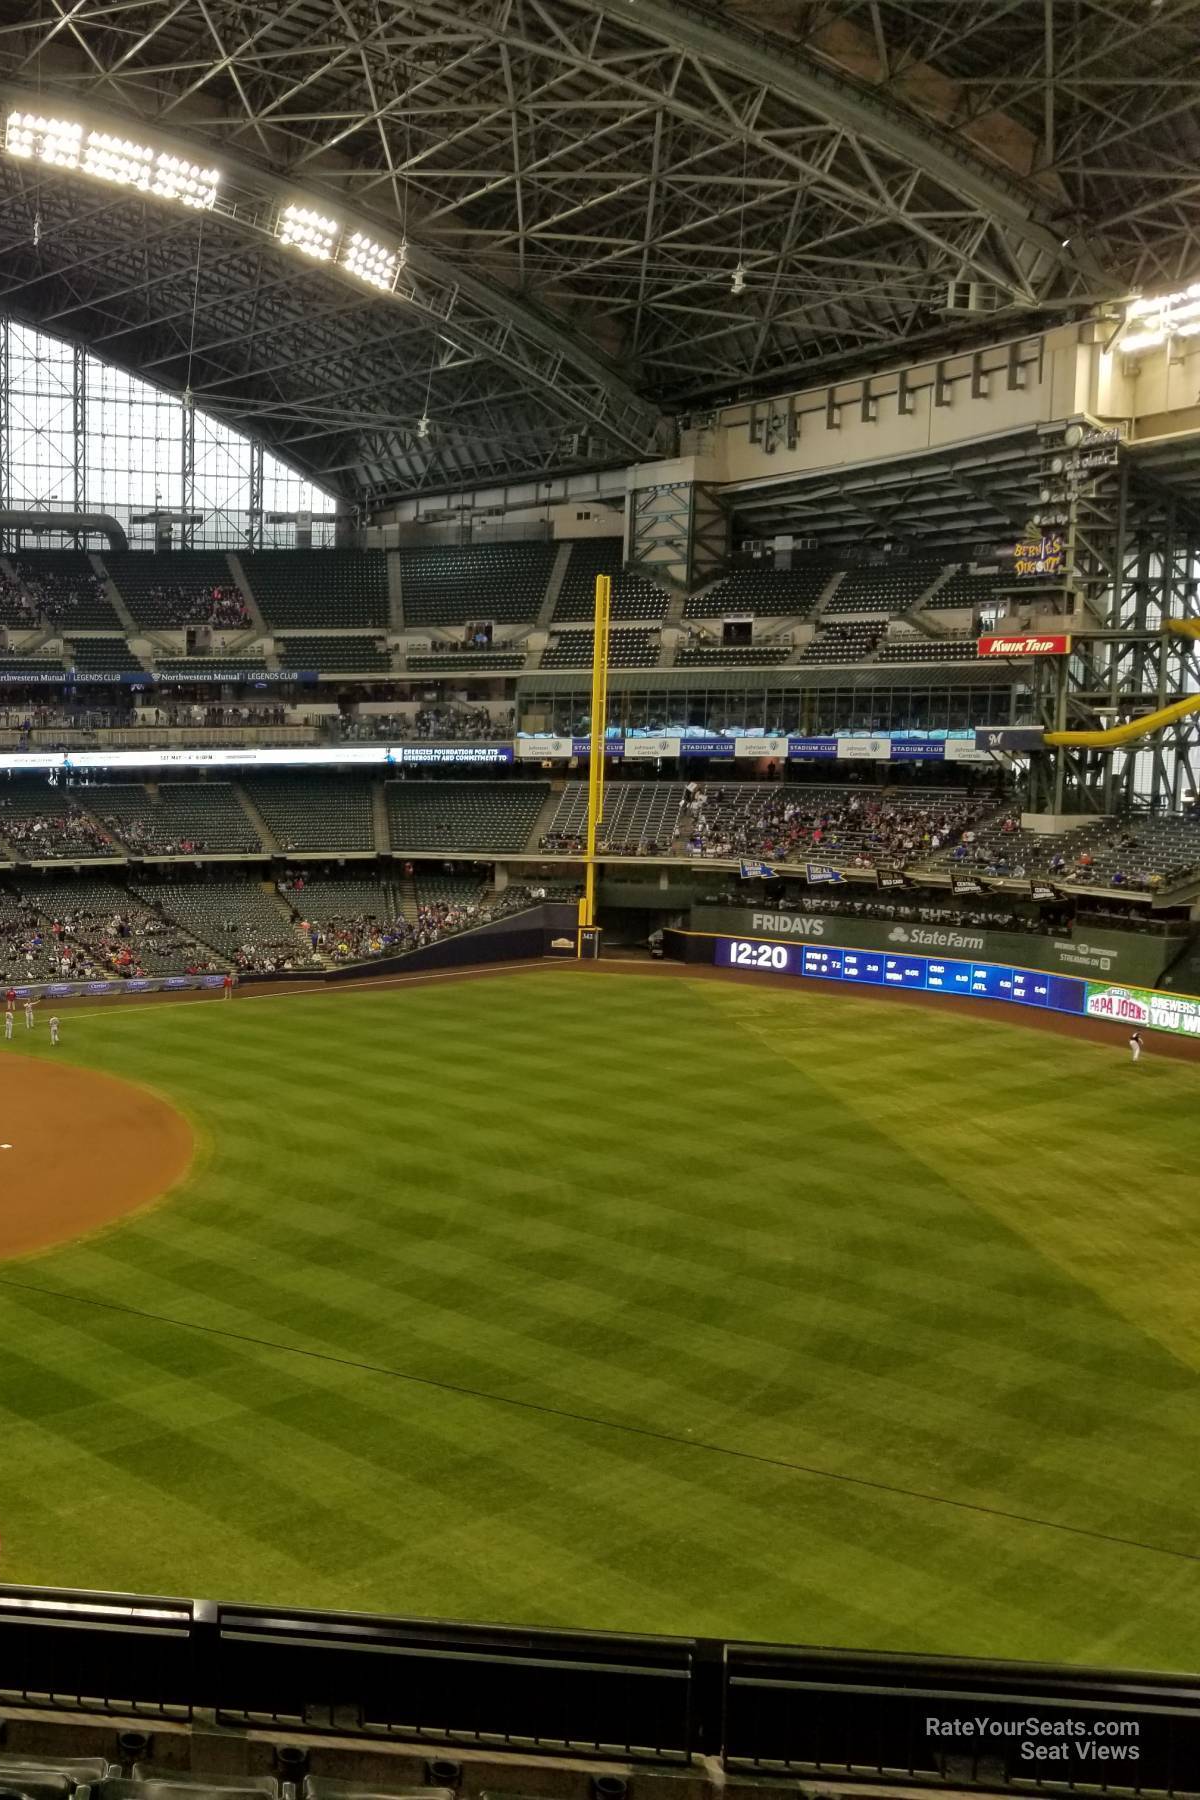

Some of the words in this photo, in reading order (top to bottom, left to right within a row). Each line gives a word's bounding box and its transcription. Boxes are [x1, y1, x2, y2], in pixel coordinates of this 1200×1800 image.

[990, 640, 1023, 653] KWIK
[1025, 639, 1054, 651] TRIP
[41, 673, 66, 682] Mutual
[73, 673, 103, 681] LEGENDS
[104, 673, 121, 681] CLUB
[161, 672, 212, 681] Northwestern
[214, 672, 240, 681] Mutual
[247, 672, 279, 680] LEGENDS
[280, 672, 298, 680] CLUB
[752, 913, 825, 936] FRIDAYS
[730, 941, 788, 969] 12:20
[831, 961, 841, 969] T2
[972, 982, 988, 991] ATL
[1090, 997, 1113, 1015] PAPA
[1151, 996, 1196, 1014] BREWERS
[1150, 1010, 1180, 1029] YOU
